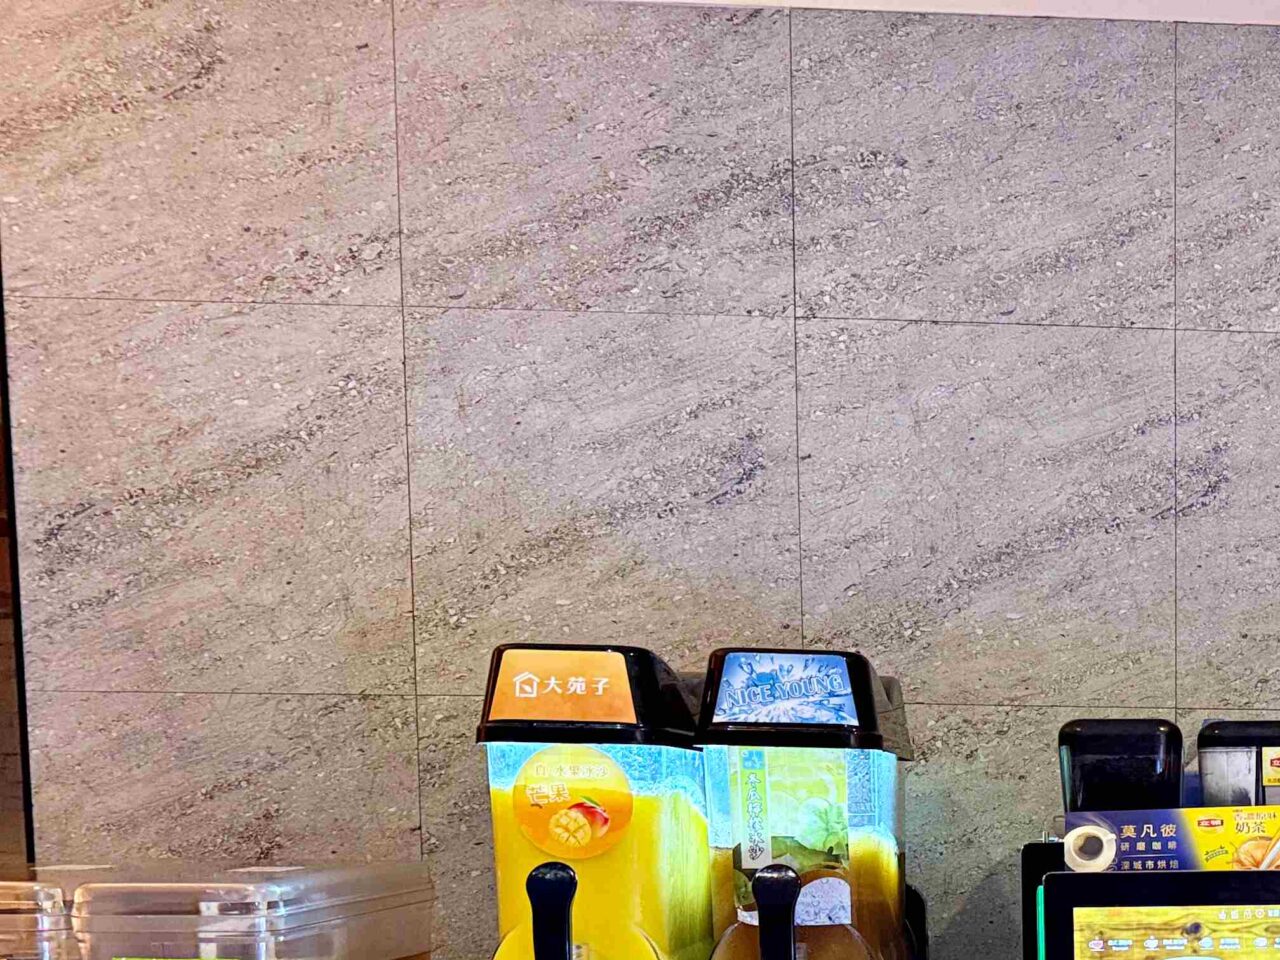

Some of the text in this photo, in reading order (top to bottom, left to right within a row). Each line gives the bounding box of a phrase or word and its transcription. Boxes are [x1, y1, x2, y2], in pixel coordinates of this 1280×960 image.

[544, 676, 610, 696] 大苑子
[726, 675, 845, 707] NICE YOUNG
[527, 783, 571, 804] 芒果
[1120, 824, 1177, 838] 莫凡彼
[1235, 822, 1266, 834] 奶茶
[1120, 841, 1177, 851] 研磨咖啡
